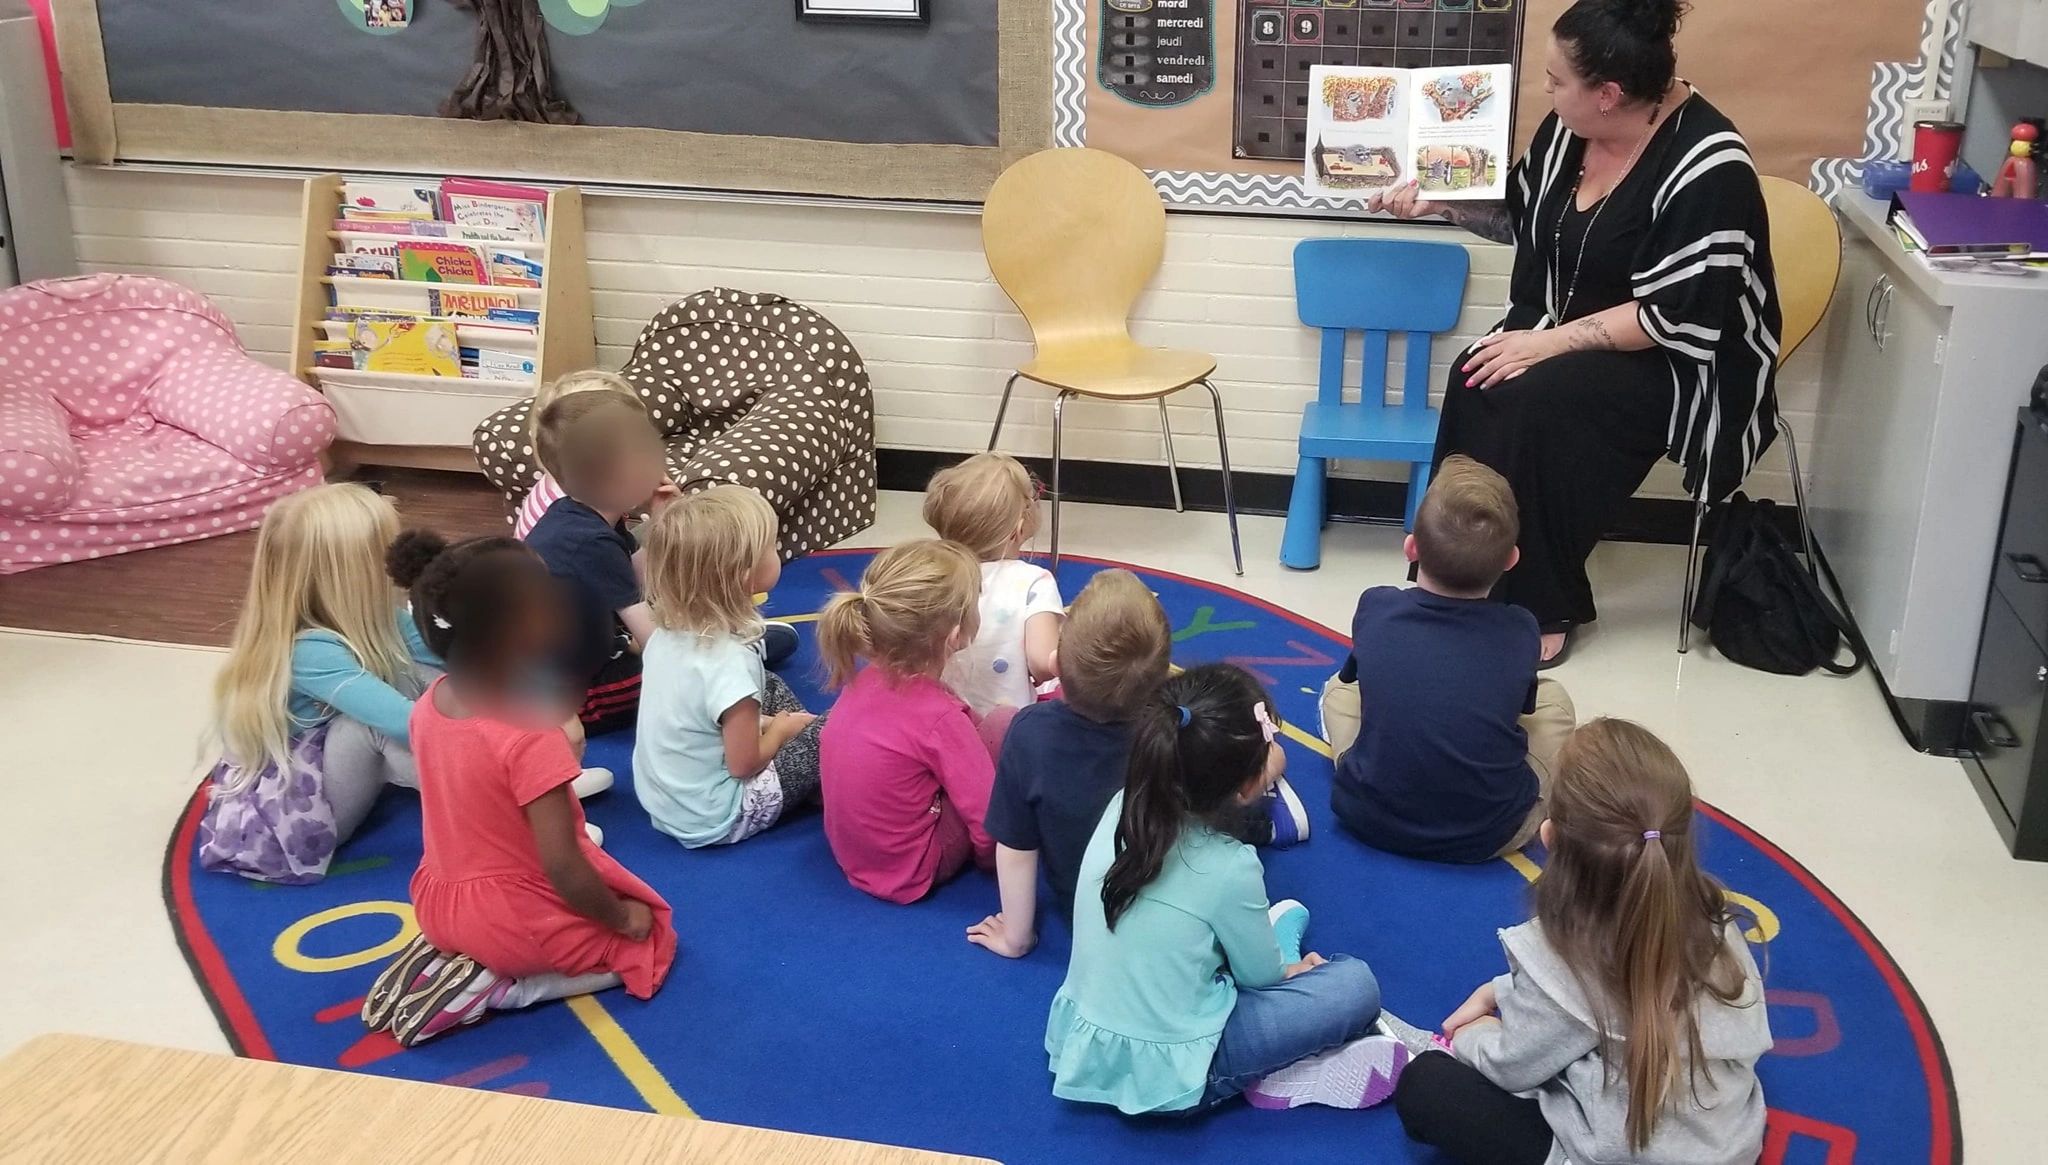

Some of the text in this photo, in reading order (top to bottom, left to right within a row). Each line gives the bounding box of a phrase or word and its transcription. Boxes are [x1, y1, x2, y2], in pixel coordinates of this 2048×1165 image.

[1157, 18, 1204, 28] mercredi
[1262, 19, 1312, 35] 8 9
[1156, 36, 1182, 48] jeudi
[1157, 55, 1205, 65] vendredi
[1156, 73, 1193, 84] samedi
[435, 256, 471, 266] Chicka
[438, 266, 474, 276] Chicka
